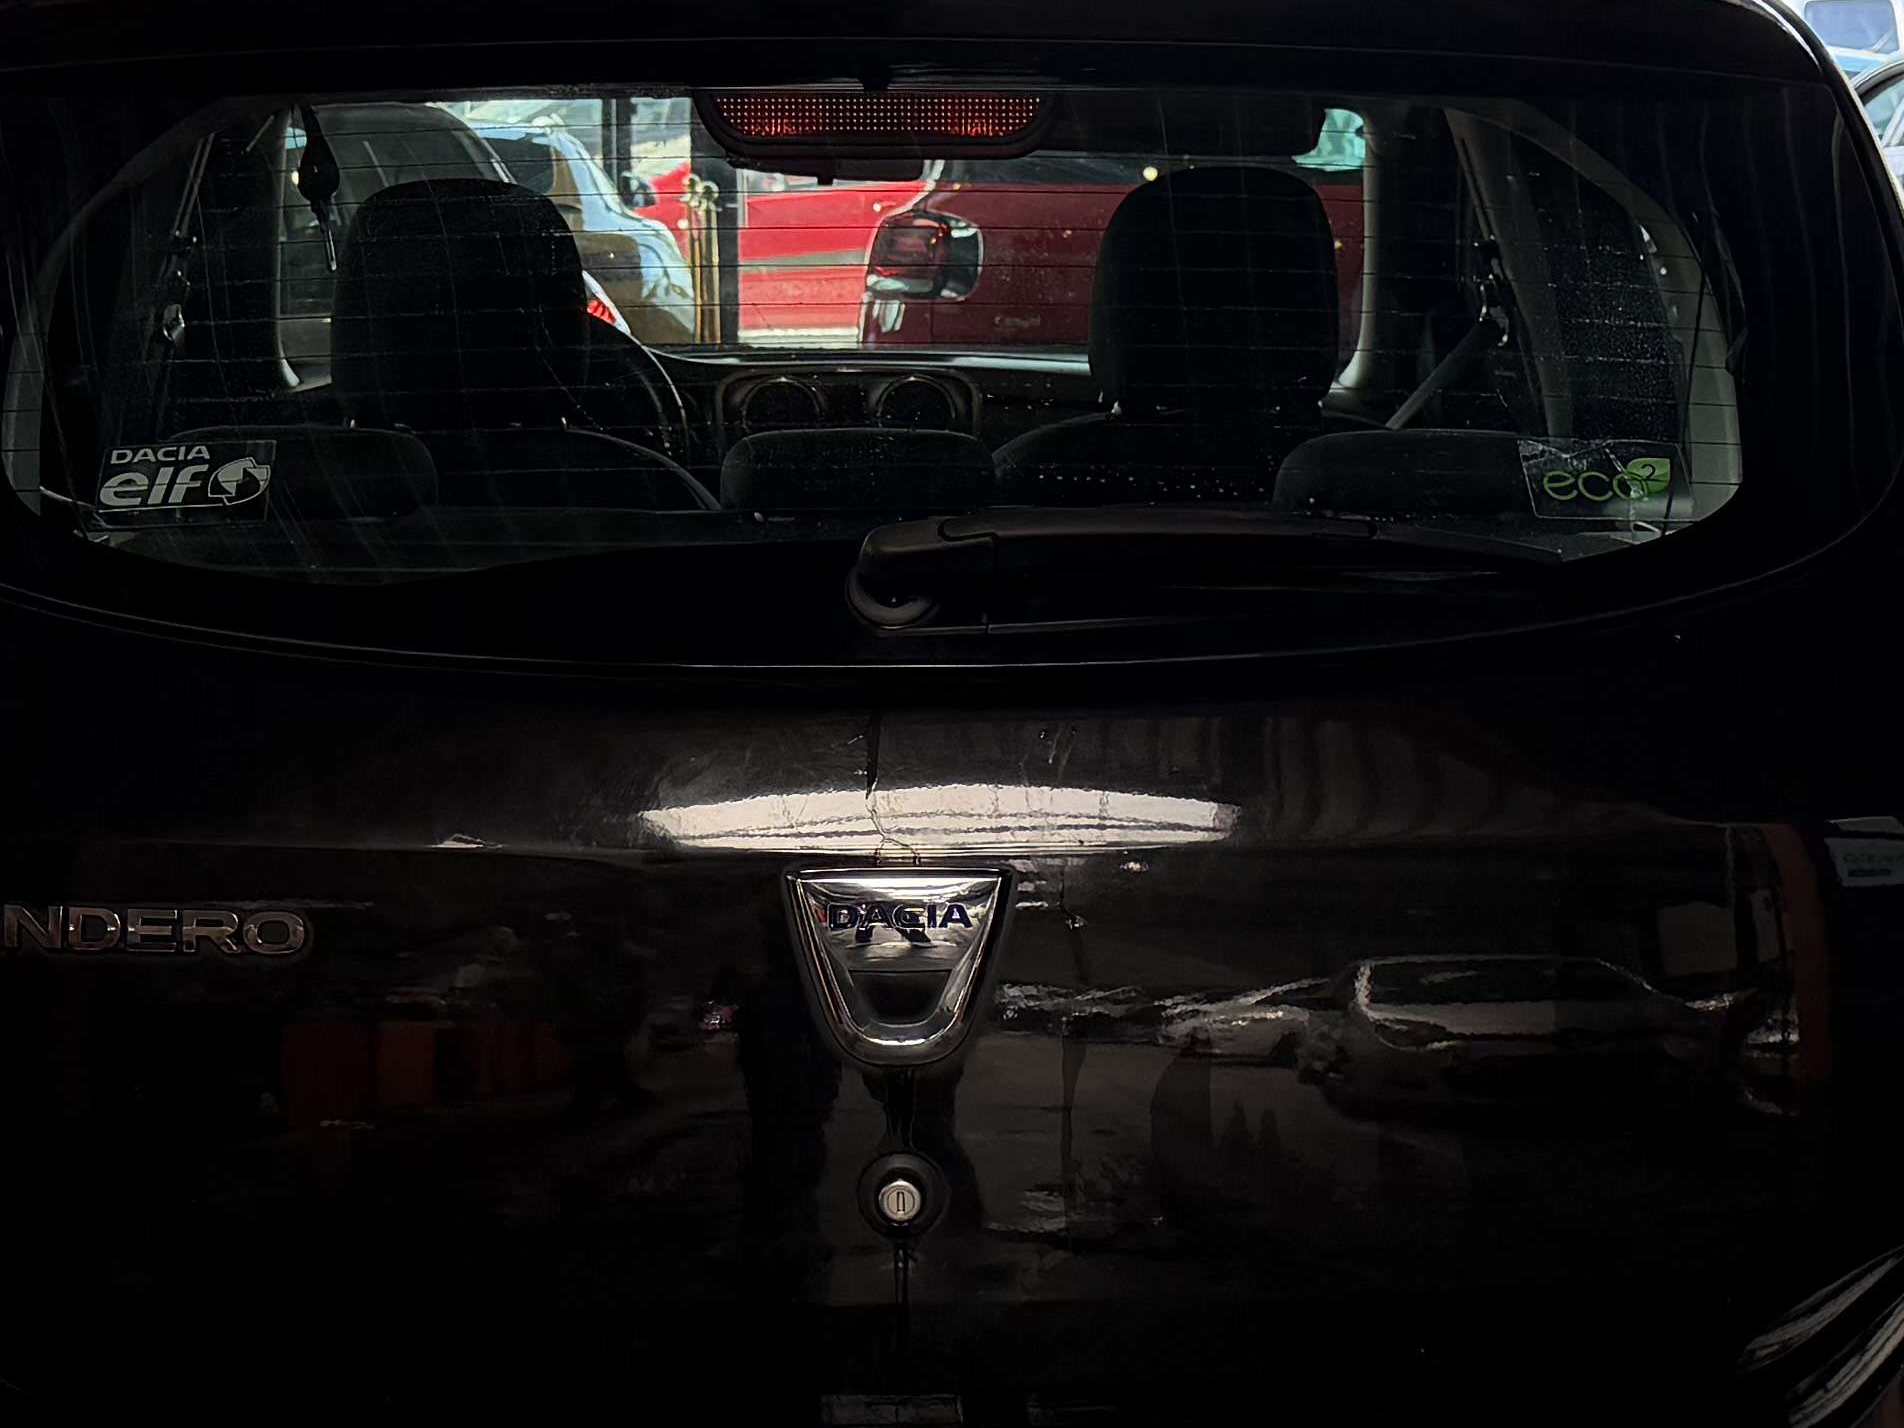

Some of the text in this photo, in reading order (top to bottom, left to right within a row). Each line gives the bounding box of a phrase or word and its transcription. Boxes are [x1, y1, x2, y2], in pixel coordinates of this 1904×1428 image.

[110, 445, 211, 465] DACIA
[99, 464, 211, 507] elf
[827, 902, 974, 929] DACIA
